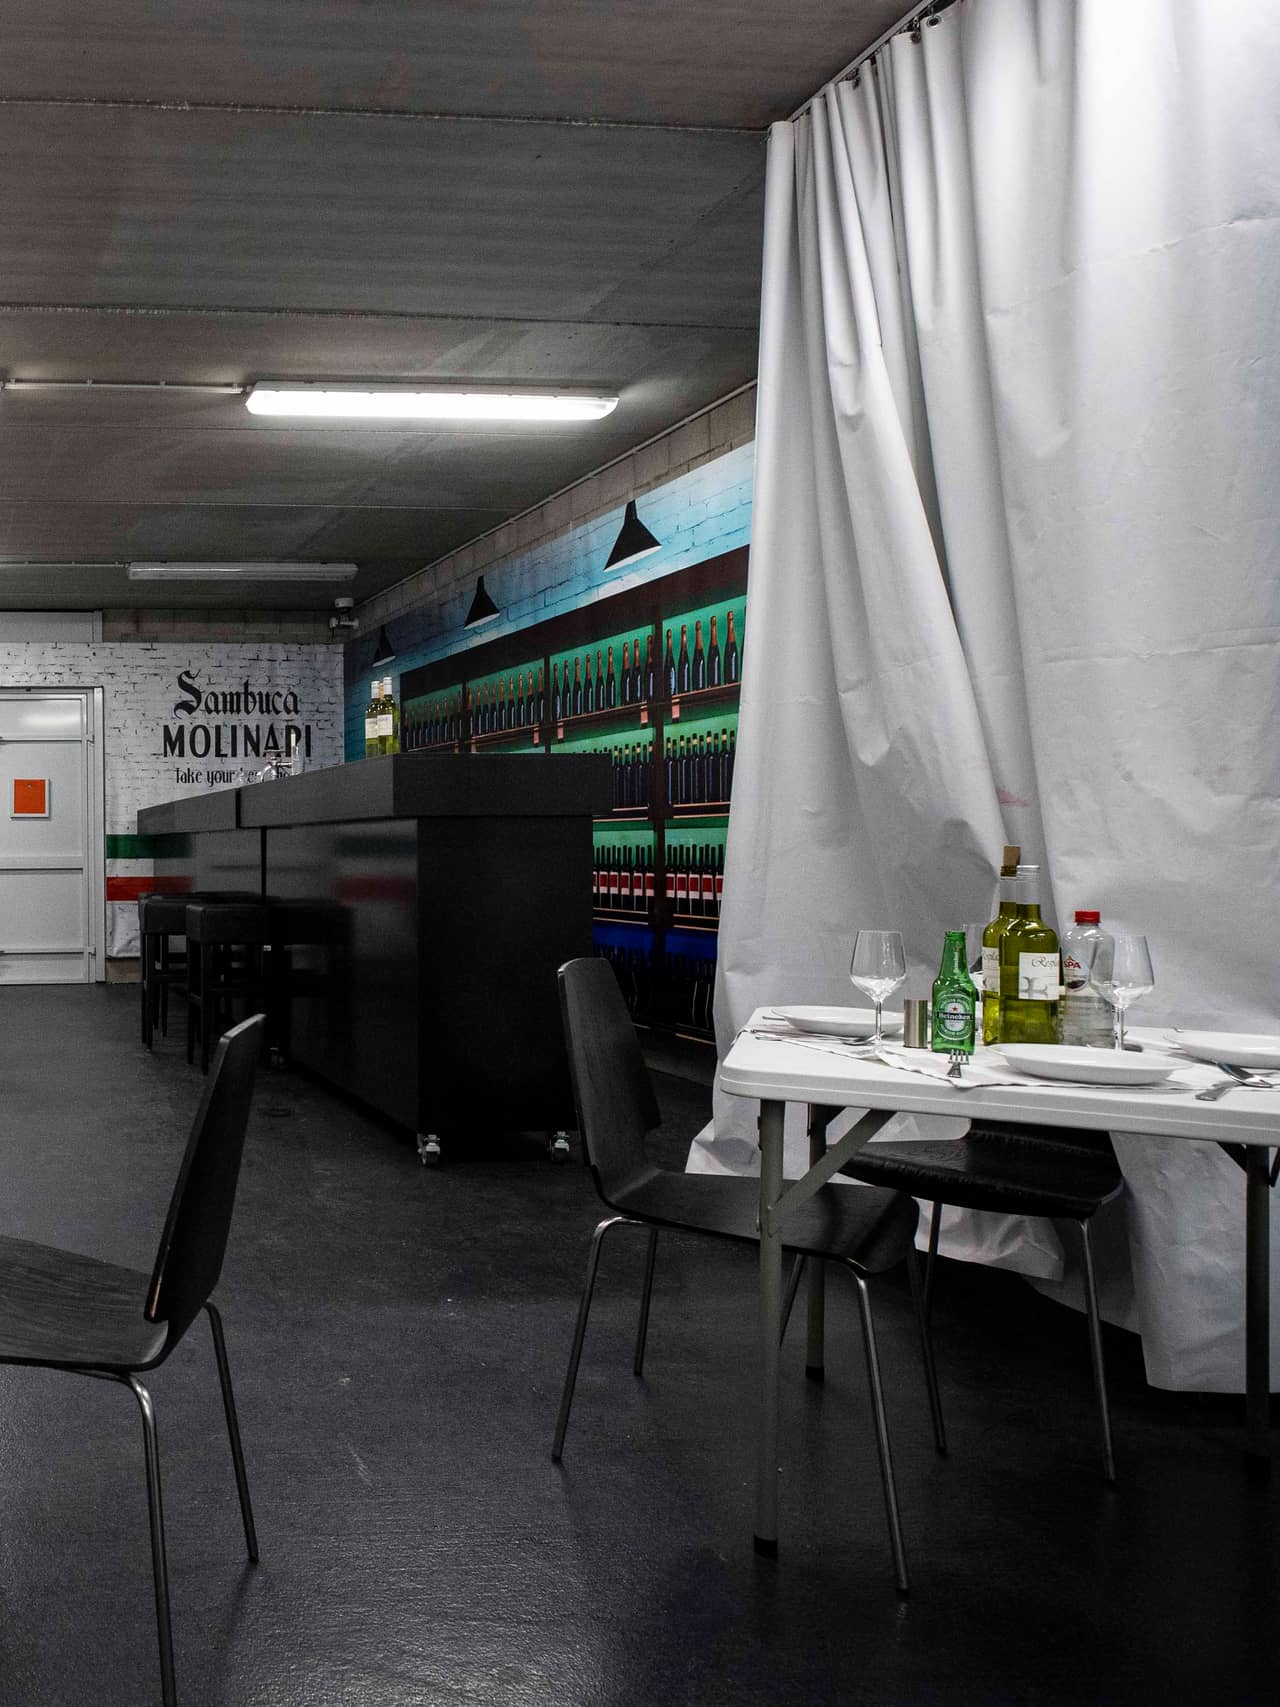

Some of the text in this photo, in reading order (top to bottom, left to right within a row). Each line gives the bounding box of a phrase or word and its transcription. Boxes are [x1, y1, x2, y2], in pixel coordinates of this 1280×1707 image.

[173, 669, 301, 720] Sambuca
[206, 769, 237, 787] your
[1063, 960, 1082, 969] SPA
